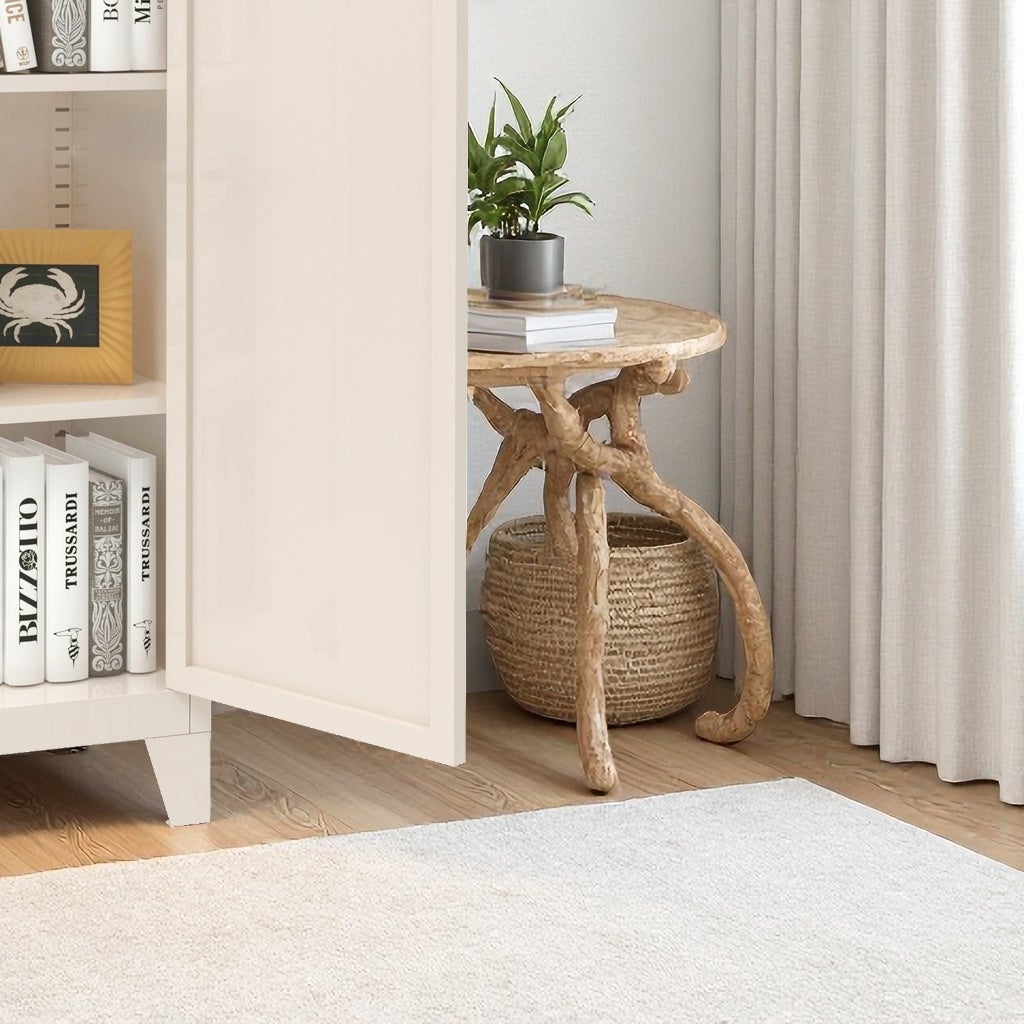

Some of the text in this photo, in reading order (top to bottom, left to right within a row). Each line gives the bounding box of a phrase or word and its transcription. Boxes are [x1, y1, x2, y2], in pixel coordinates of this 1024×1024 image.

[94, 508, 120, 516] MEMOIR
[94, 525, 119, 533] BALZAC
[141, 486, 151, 582] TRUSSARDI
[65, 492, 78, 590] TRUSSARDI
